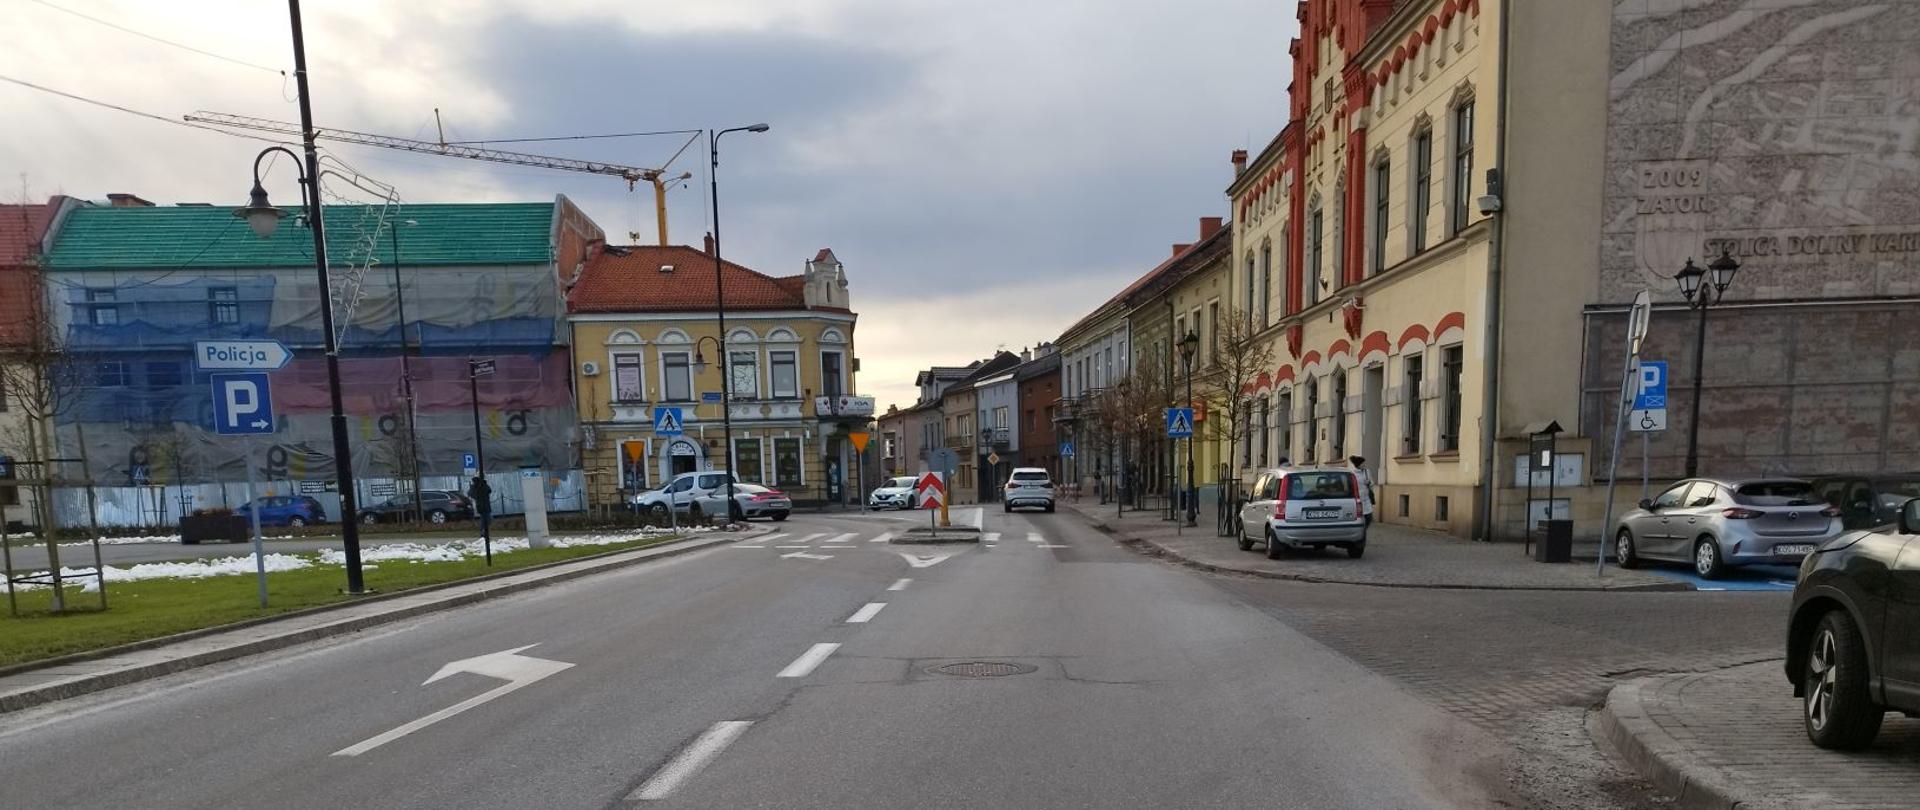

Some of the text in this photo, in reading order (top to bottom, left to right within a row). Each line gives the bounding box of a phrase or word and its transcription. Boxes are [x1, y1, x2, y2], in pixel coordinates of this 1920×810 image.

[1643, 168, 1702, 188] 2009
[1702, 236, 1781, 258] STOLICA
[1786, 233, 1867, 256] DOLINY
[206, 346, 267, 365] Policja
[1639, 366, 1660, 395] P
[225, 381, 258, 427] P
